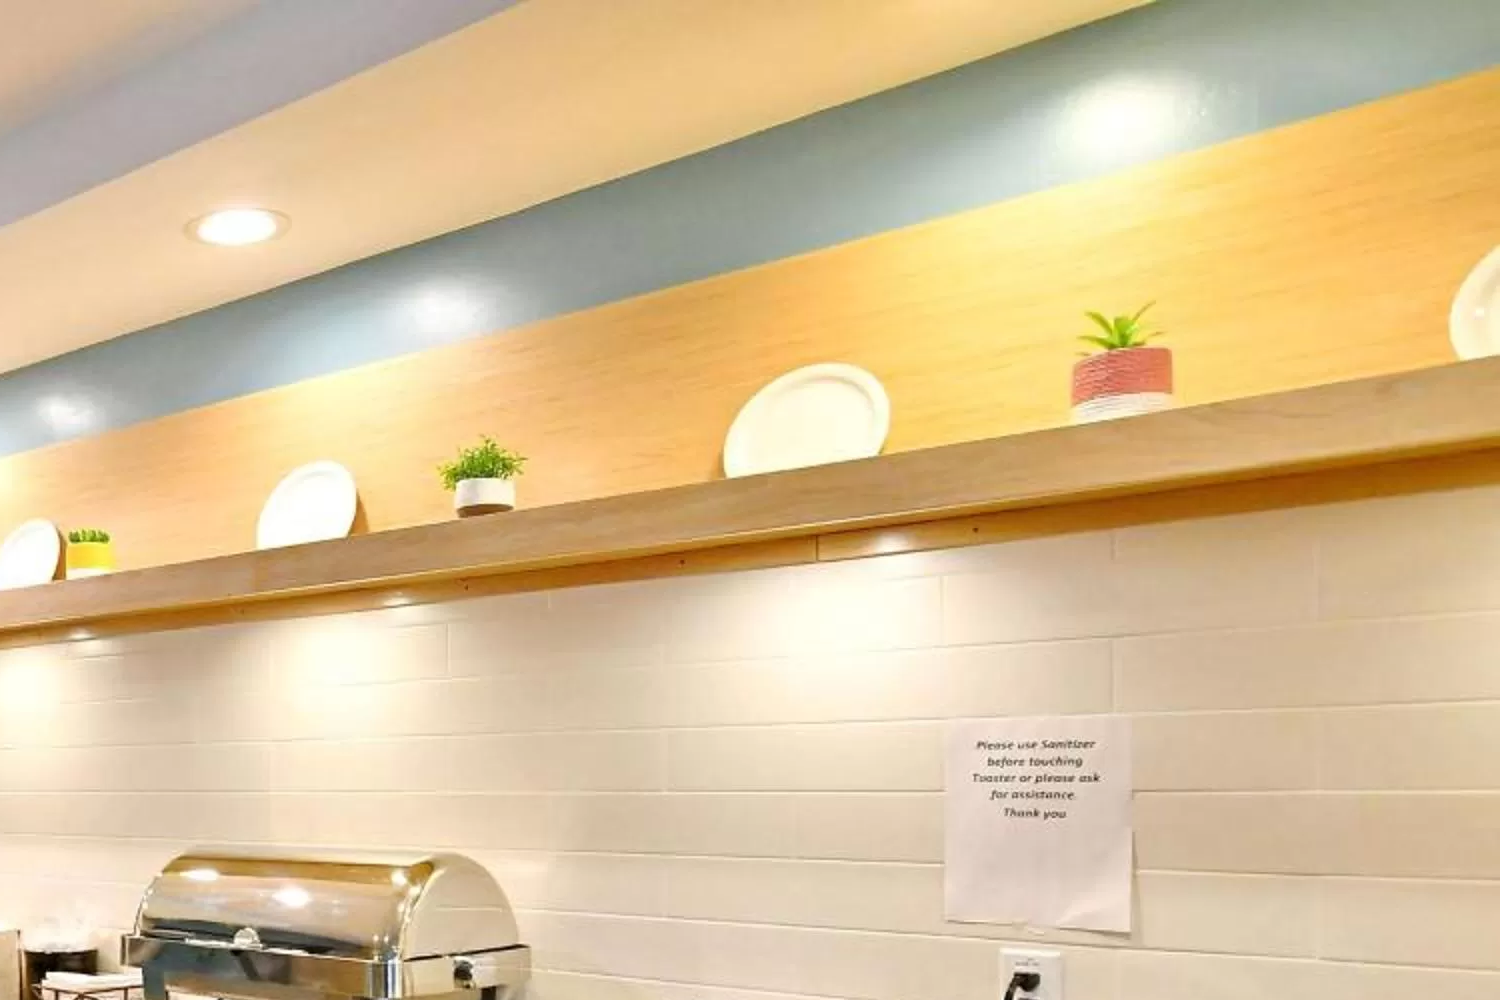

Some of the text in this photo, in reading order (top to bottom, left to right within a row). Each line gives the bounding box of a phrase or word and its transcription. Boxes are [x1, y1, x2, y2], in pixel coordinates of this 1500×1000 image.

[976, 739, 1096, 750] Please use Sanitizer
[987, 756, 1083, 768] before touching
[972, 773, 1100, 784] Toaster or please ask
[989, 790, 1009, 800] for
[1004, 808, 1067, 820] Thank you
